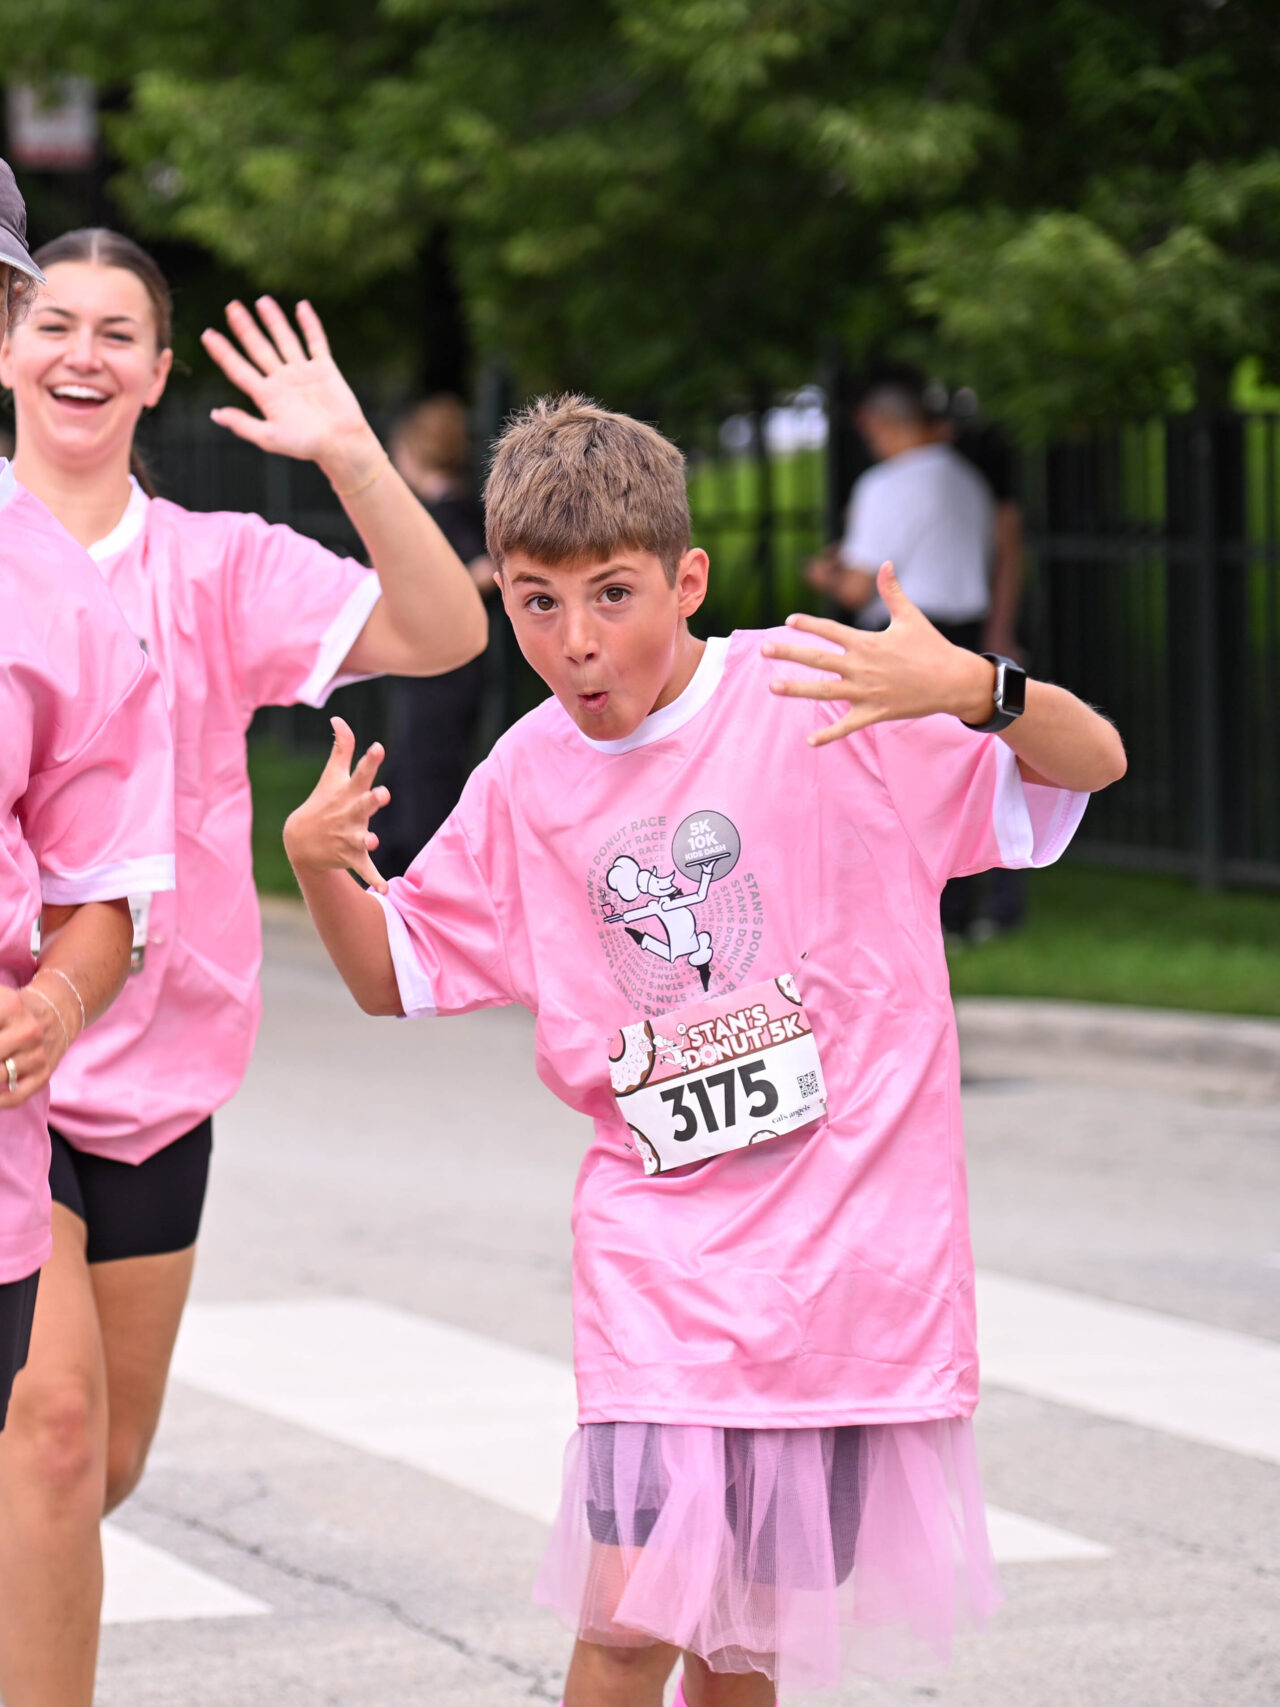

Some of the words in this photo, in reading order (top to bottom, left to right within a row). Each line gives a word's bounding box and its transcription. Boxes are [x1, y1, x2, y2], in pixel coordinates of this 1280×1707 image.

[593, 826, 627, 866] DONUT
[631, 816, 667, 832] RACE
[635, 832, 667, 845] RACE
[687, 832, 719, 851] 10K
[689, 818, 712, 836] 5K
[704, 844, 726, 856] DASH
[731, 879, 748, 925] STAN'S
[744, 872, 764, 925] STAN'S
[723, 928, 748, 973] DONUT
[735, 930, 763, 982] DONUT
[646, 992, 687, 1004] STAN'S
[649, 981, 685, 991] STAN'S
[683, 1029, 766, 1072] DONUT
[768, 1013, 804, 1045] 5K
[687, 1004, 768, 1047] STAN'S
[660, 1059, 779, 1142] 3175
